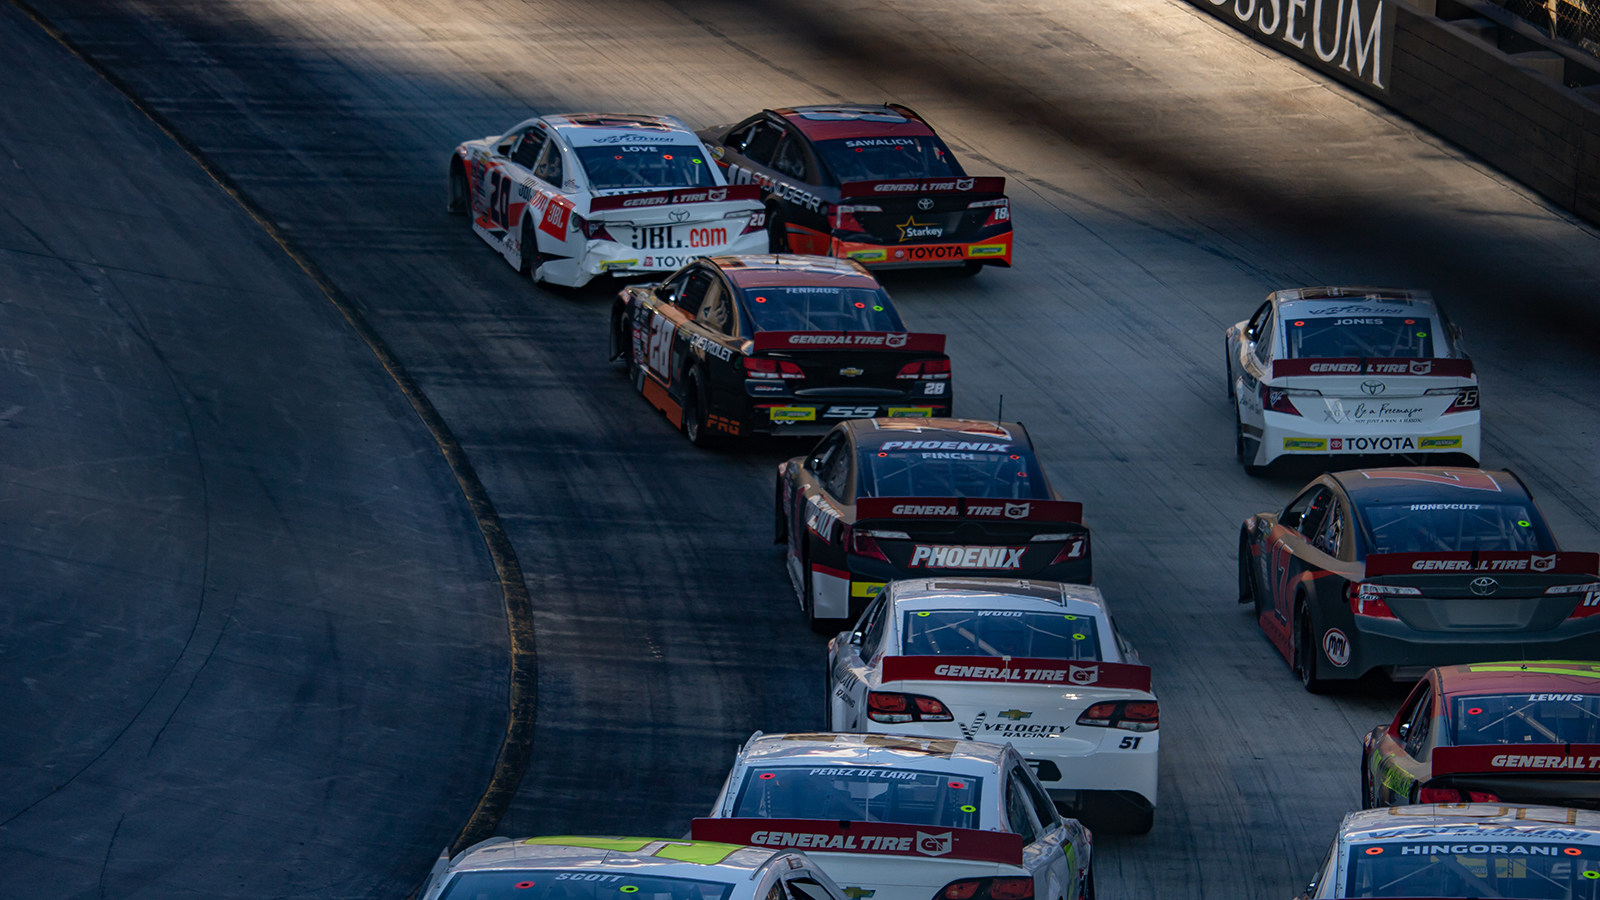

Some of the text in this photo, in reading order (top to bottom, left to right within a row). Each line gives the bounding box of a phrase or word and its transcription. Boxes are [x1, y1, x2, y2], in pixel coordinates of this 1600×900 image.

[1208, 0, 1385, 90] SEUM
[846, 138, 914, 149] SAWALICH
[929, 182, 956, 191] TIRE
[491, 170, 511, 231] 20
[680, 191, 708, 203] TIRE
[547, 203, 564, 229] JBL
[750, 213, 765, 226] 20
[994, 207, 1007, 220] 18
[632, 226, 727, 250] JBL.com
[907, 227, 943, 238] Starkey
[907, 246, 963, 259] TOYOTA
[1334, 318, 1384, 326] JONES
[788, 334, 885, 345] GENERAL TIRE
[650, 313, 676, 380] 28
[1375, 363, 1409, 373] TIRE
[924, 382, 945, 395] 28
[1454, 391, 1477, 408] 25
[881, 441, 1011, 453] PHOENIX
[1345, 437, 1415, 450] TOYOTA
[891, 504, 1004, 516] GENERA TIRE
[1410, 503, 1480, 511] HONEYCUTT
[1067, 541, 1083, 558] 1
[911, 545, 1026, 569] PHOENIX
[1491, 559, 1529, 571] TIRE
[977, 610, 1022, 618] WOOD
[934, 664, 1067, 682] GENERAL TIRE
[1528, 693, 1584, 702] LEWIS
[984, 723, 1070, 734] VELOCITY
[1117, 738, 1142, 751] 51
[1491, 754, 1586, 769] GENERAL
[810, 768, 918, 782] PEREZ DE LARA
[751, 830, 914, 852] GENERAL TIRE
[1452, 833, 1584, 842] MOTORSPORTS
[1402, 844, 1558, 857] HINGORANI
[556, 872, 622, 882] SCOTT
